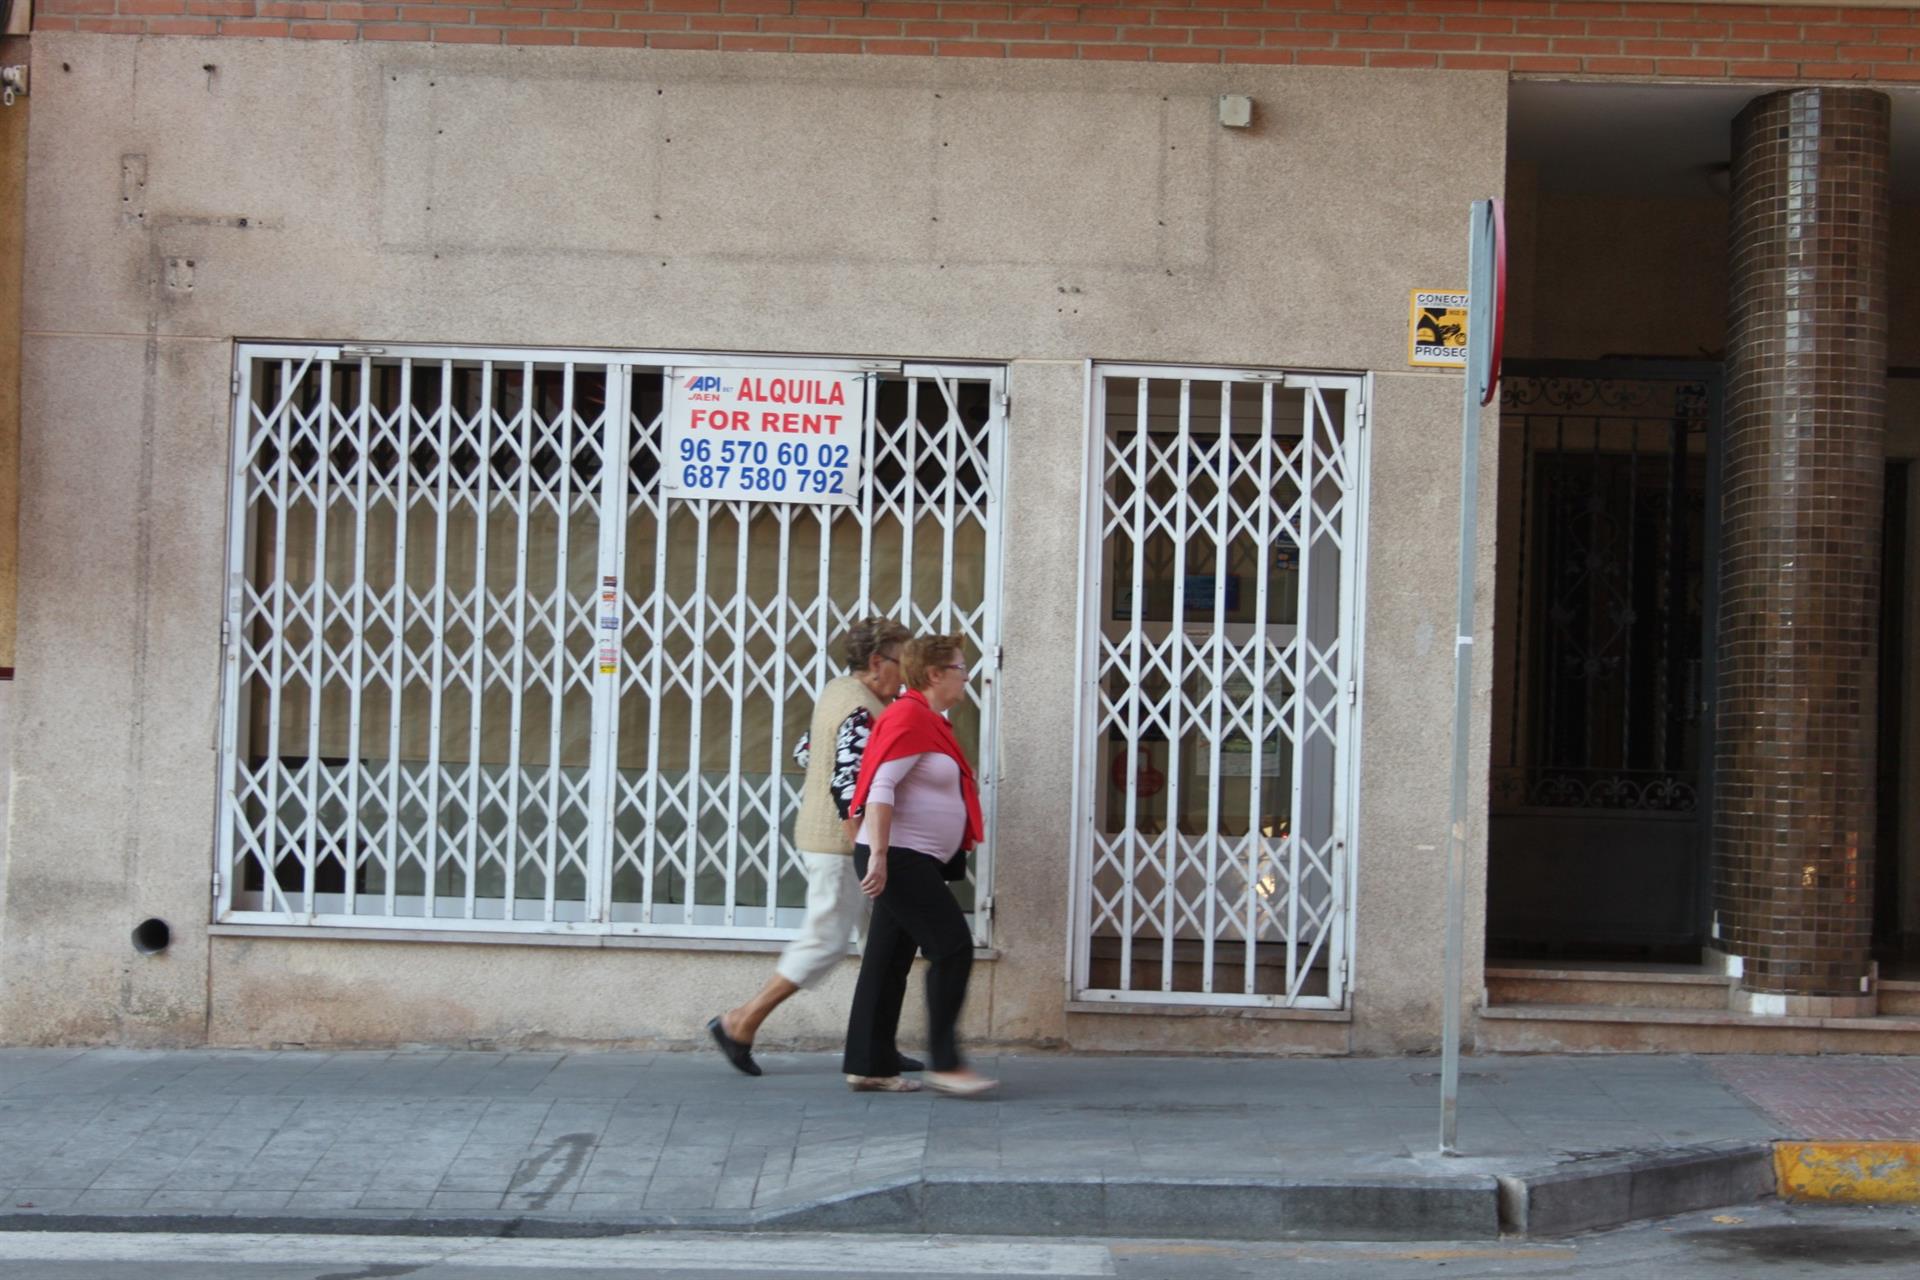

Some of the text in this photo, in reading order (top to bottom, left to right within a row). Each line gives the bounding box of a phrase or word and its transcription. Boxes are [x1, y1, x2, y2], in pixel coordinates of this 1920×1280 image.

[689, 375, 721, 392] API
[737, 377, 845, 406] ALQUILA
[688, 393, 721, 402] JAEN
[690, 409, 843, 435] FOR RENT
[680, 438, 849, 468] 96 570 60 02
[683, 464, 844, 494] 687 580 792
